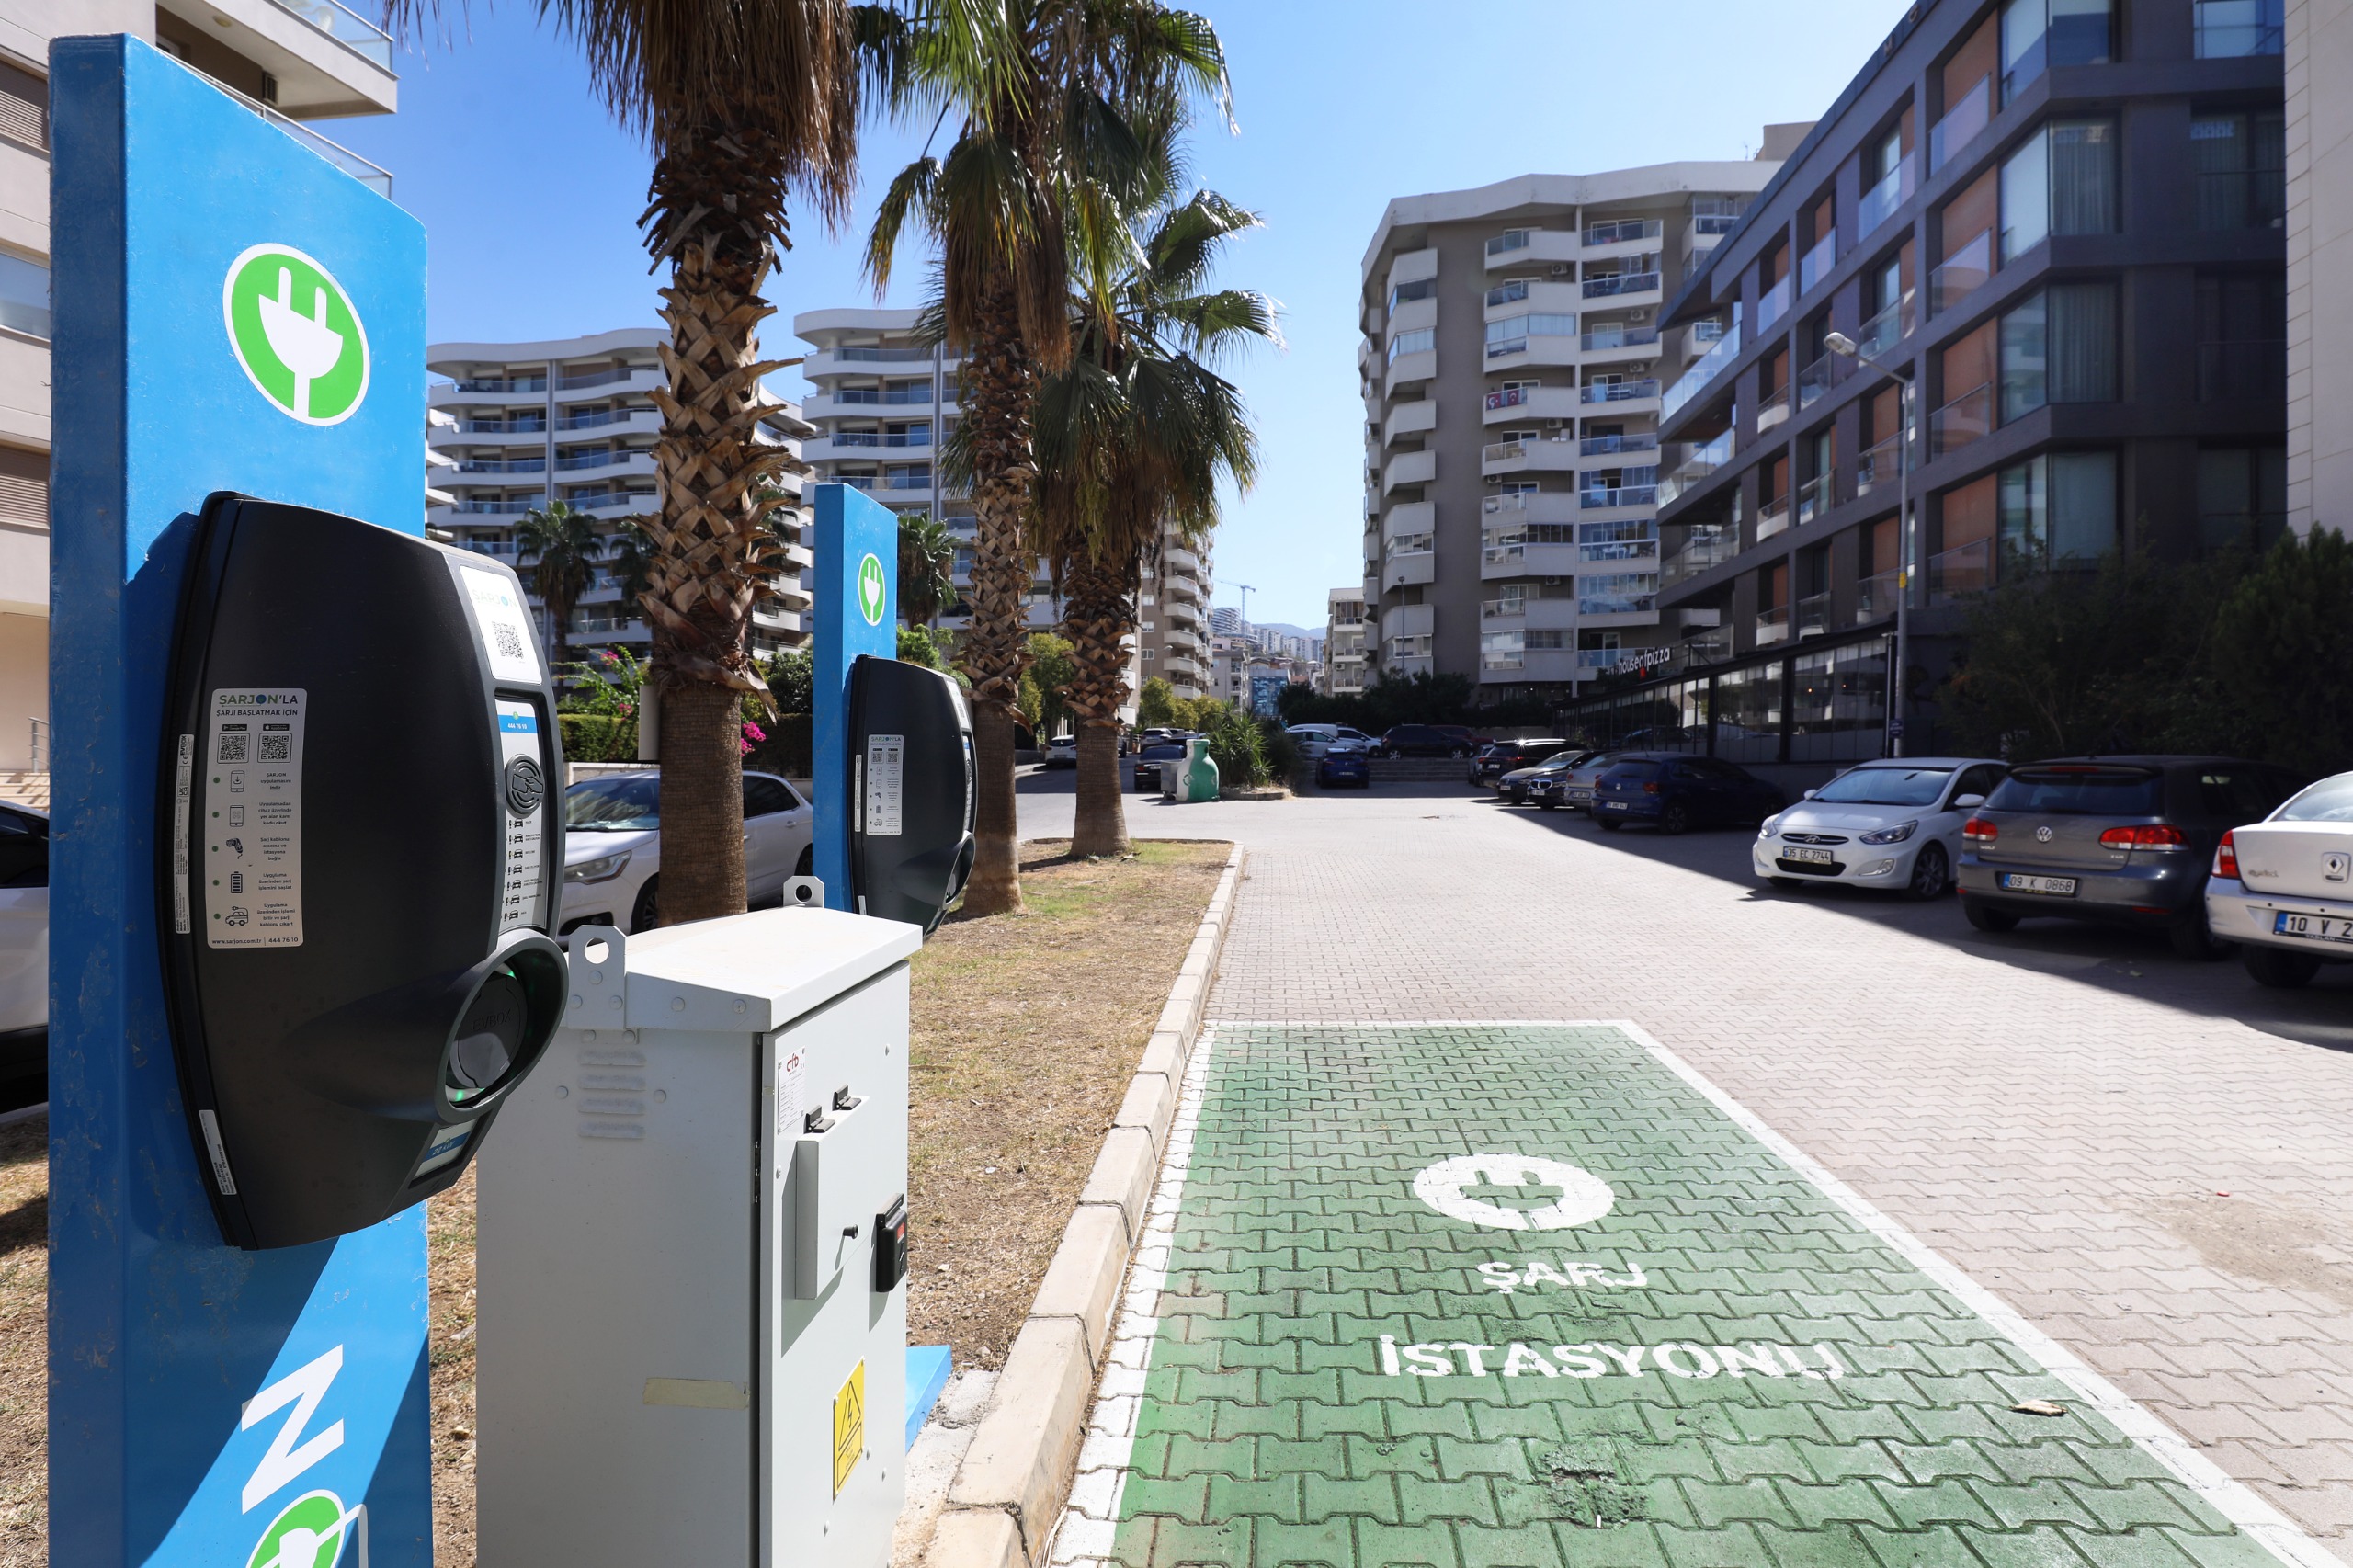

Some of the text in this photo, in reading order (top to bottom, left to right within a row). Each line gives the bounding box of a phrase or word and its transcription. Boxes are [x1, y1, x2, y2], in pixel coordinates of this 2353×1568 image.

[2009, 875, 2022, 887] 09
[2029, 879, 2036, 889] K
[2290, 916, 2308, 932] 10
[2322, 919, 2331, 935] V
[472, 1008, 513, 1031] EVBOX
[1476, 1261, 1649, 1295] ŞARJ
[1378, 1334, 1845, 1381] İSTASYONU
